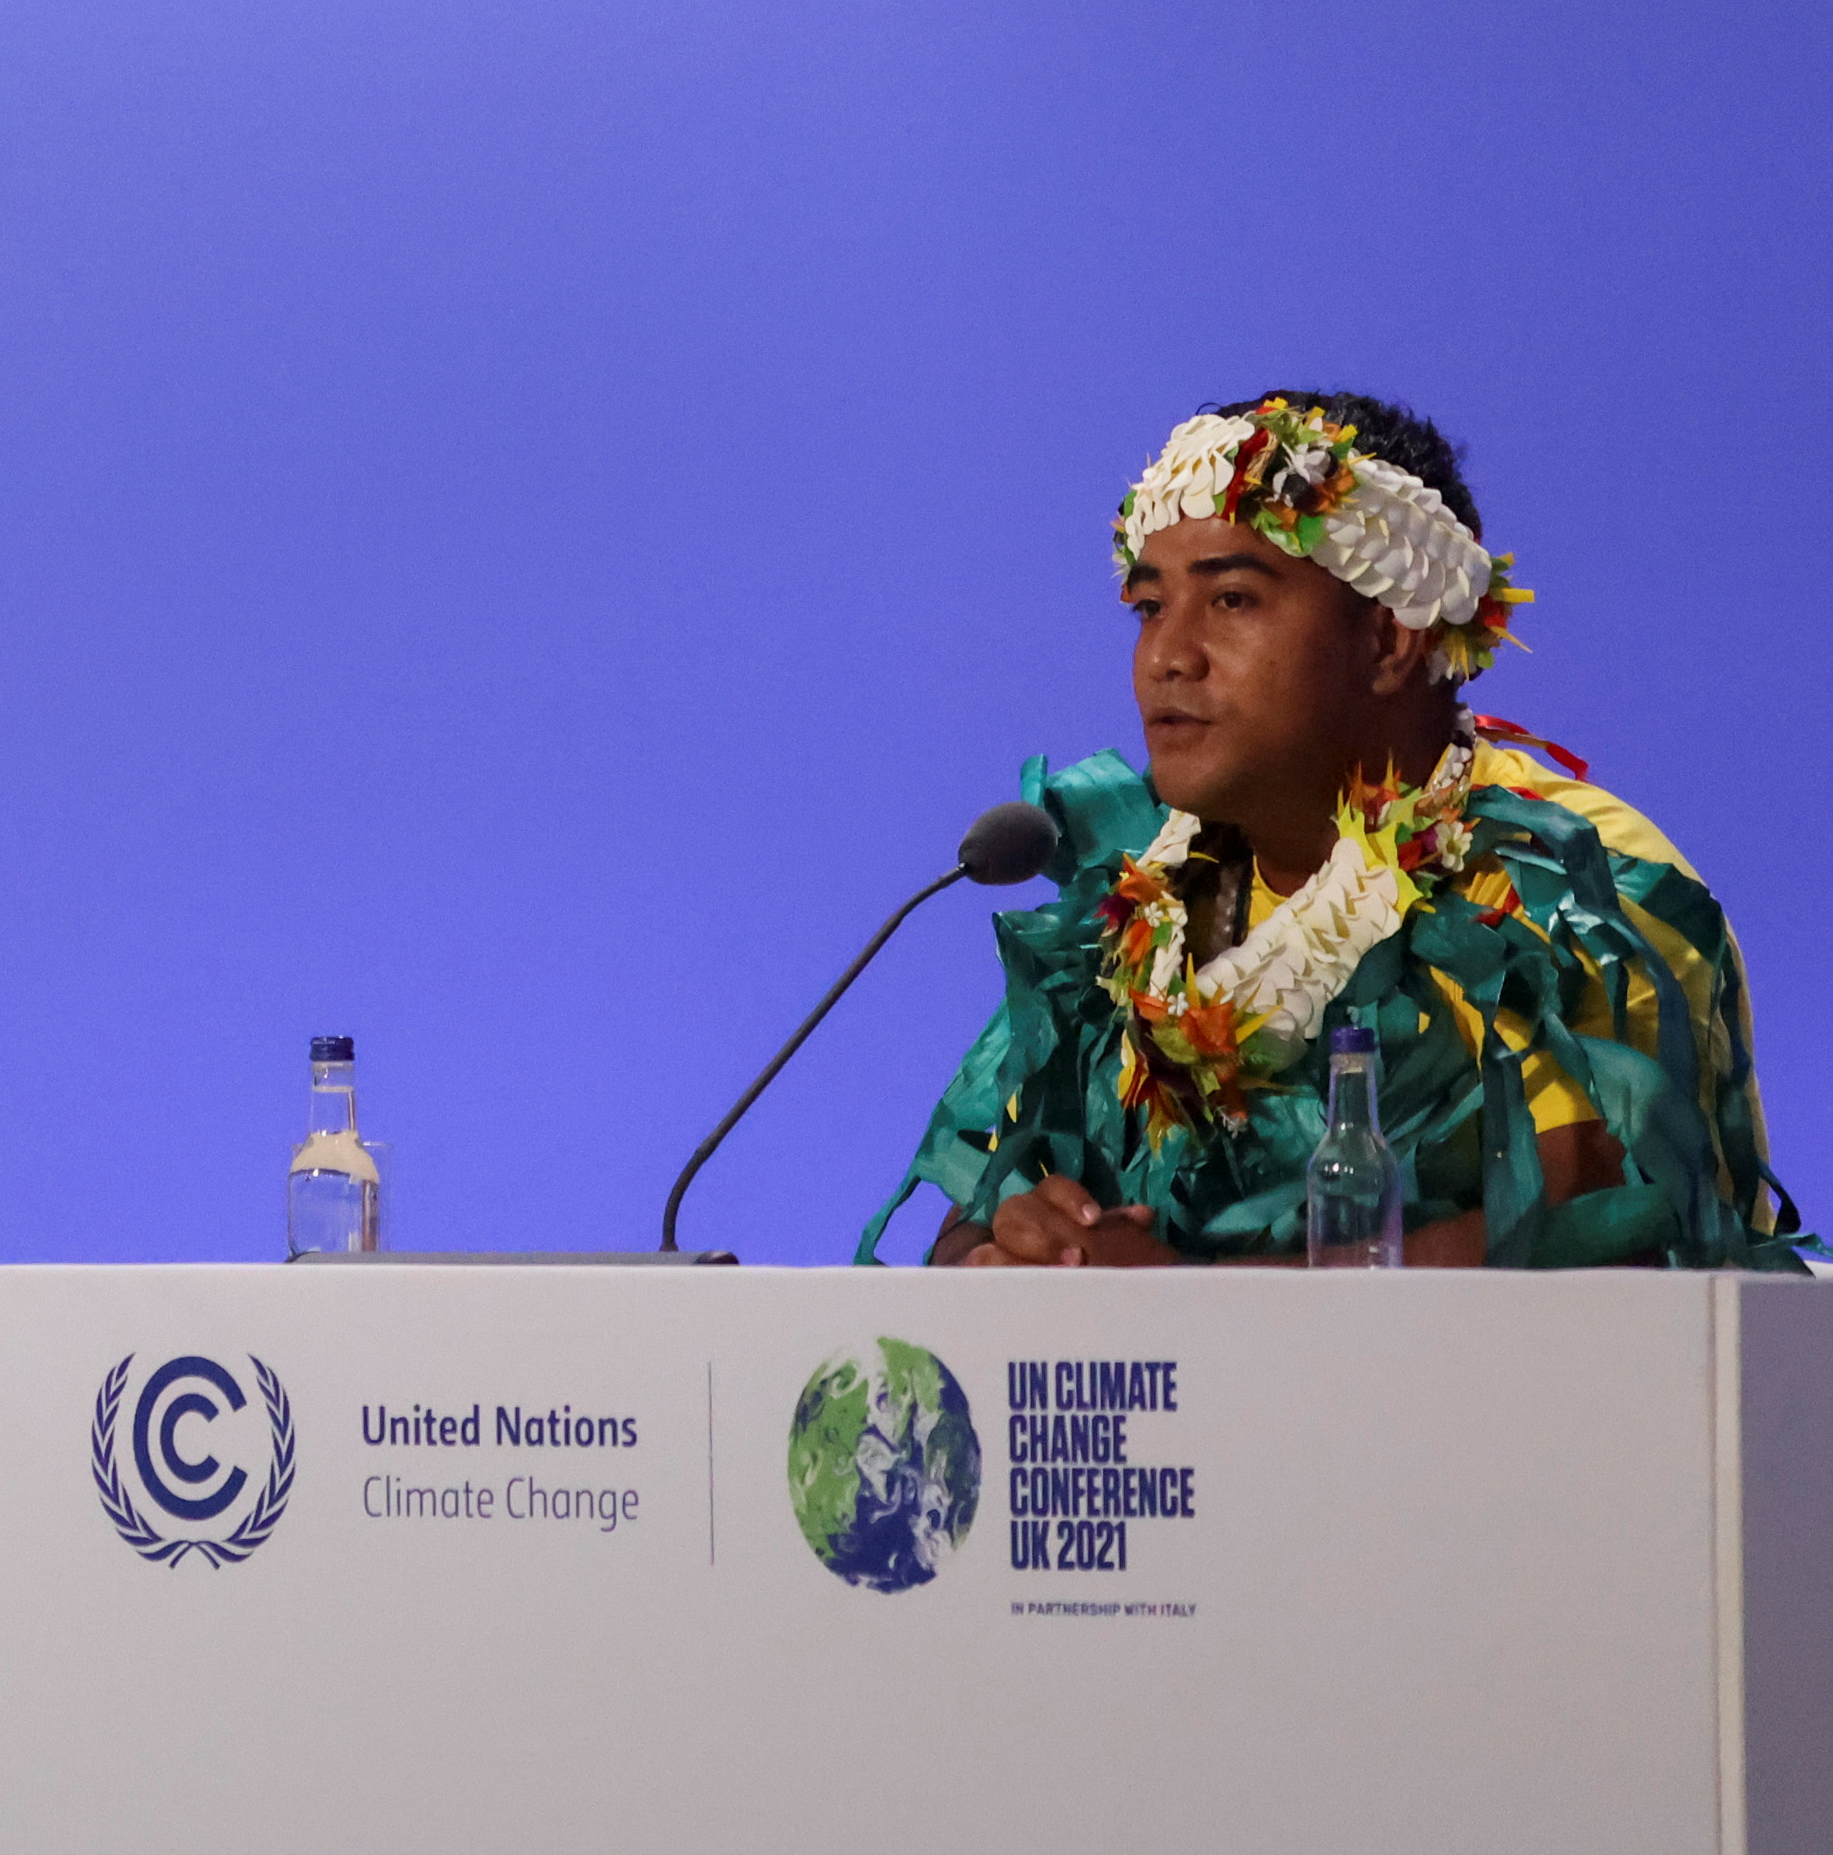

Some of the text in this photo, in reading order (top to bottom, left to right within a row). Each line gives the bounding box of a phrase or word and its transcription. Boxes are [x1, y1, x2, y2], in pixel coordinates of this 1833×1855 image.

[1008, 1361, 1178, 1412] UN CLIMATE
[362, 1403, 638, 1448] United Nations
[1008, 1413, 1128, 1466] CHANGE
[363, 1474, 640, 1533] Climate Change
[1009, 1466, 1195, 1518] CONFERENCE
[1010, 1519, 1127, 1571] UK 2021
[1011, 1602, 1196, 1617] IN PARTNERSHIP WITH ITALY
